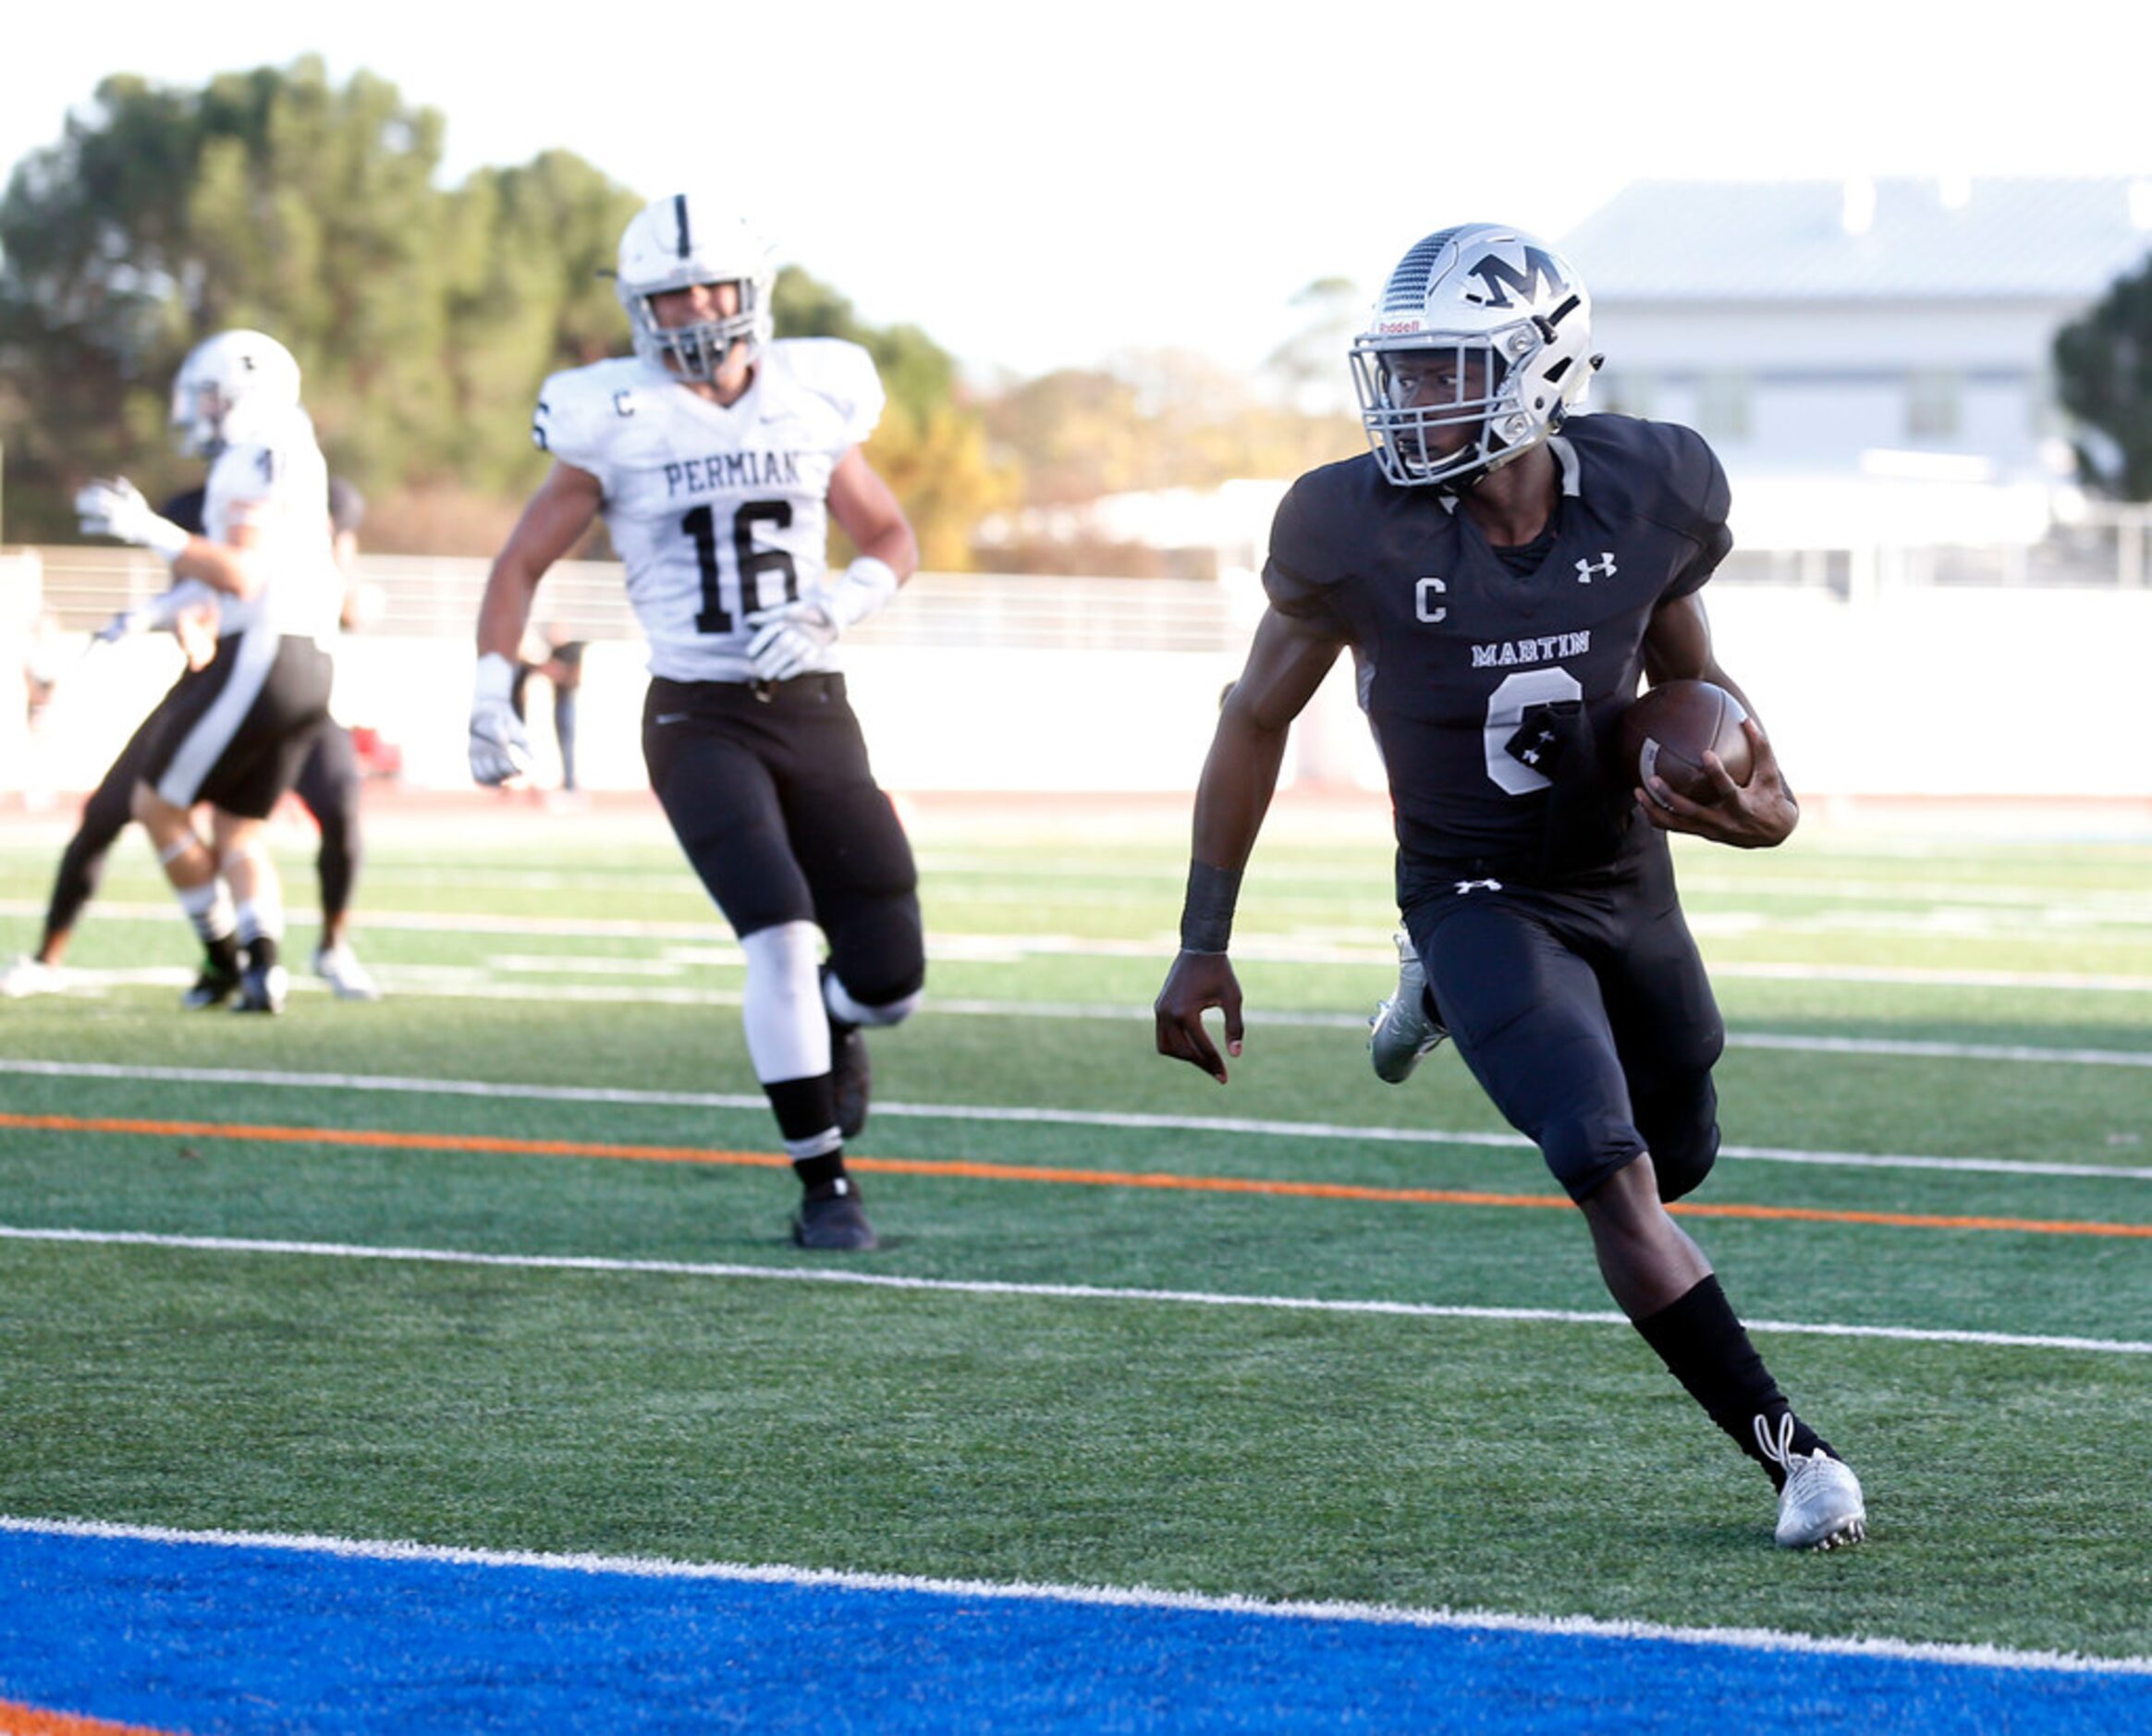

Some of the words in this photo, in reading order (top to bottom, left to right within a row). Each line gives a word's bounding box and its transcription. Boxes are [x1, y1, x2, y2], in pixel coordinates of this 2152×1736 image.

[664, 451, 801, 497] PERMIAN
[681, 499, 800, 634] 16
[1415, 577, 1447, 623] C
[1472, 630, 1591, 667] MARTIN
